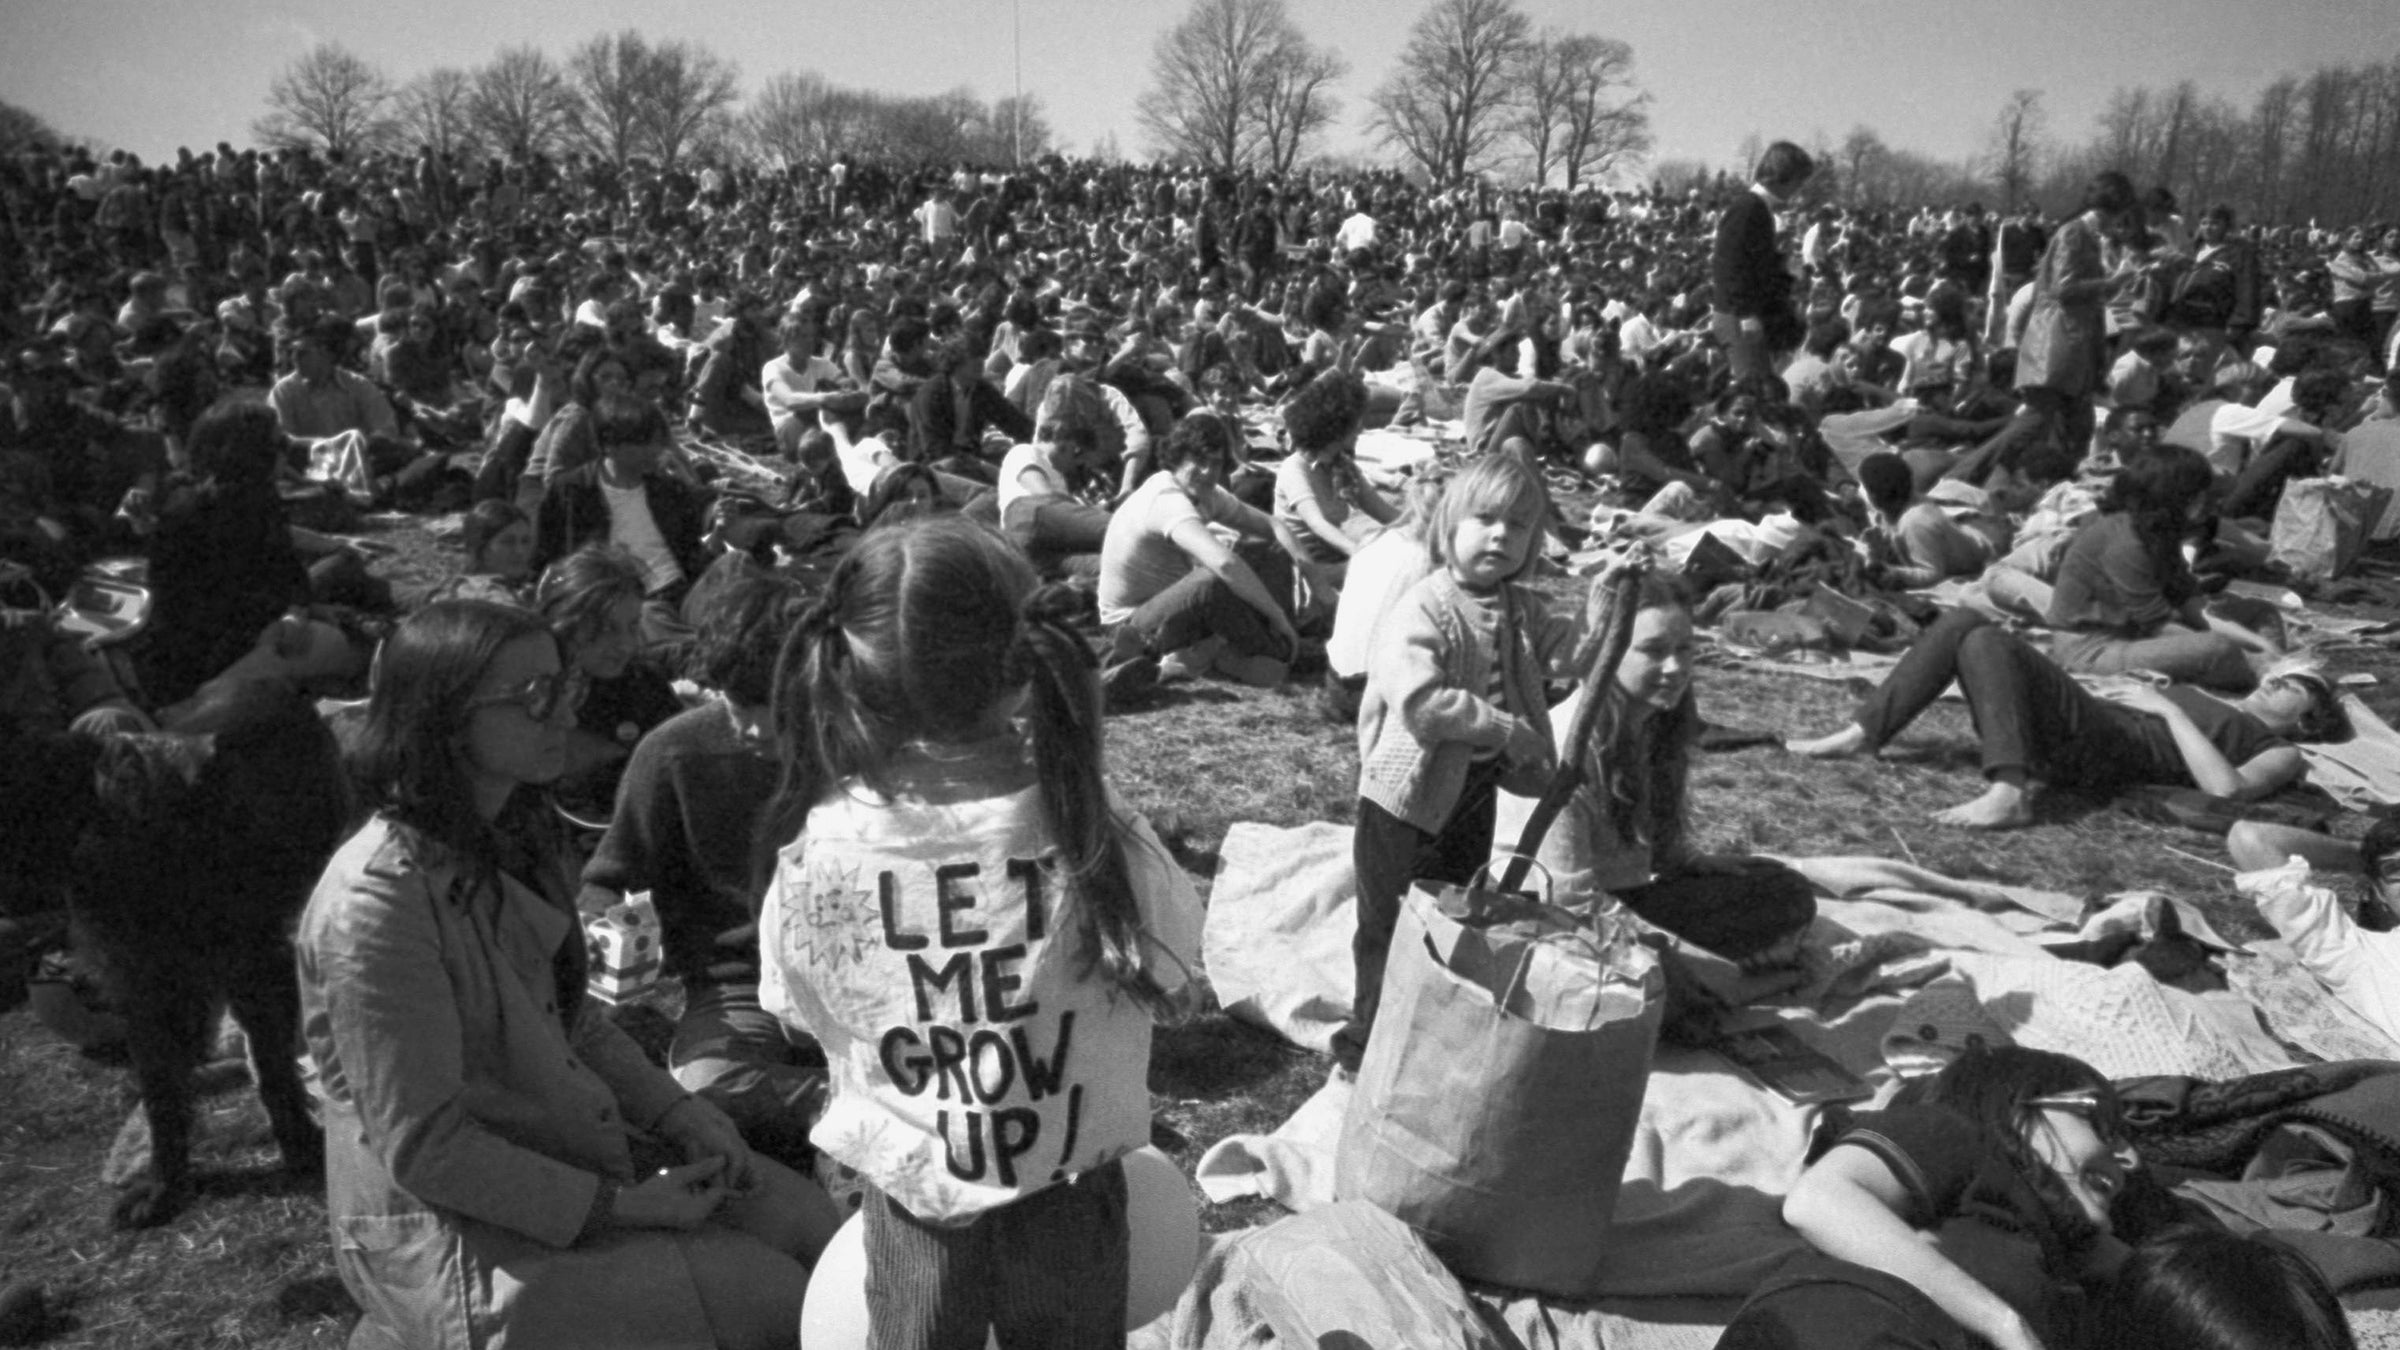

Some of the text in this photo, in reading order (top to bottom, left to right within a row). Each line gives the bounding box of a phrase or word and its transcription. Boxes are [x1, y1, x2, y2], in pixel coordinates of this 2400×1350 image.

[878, 858, 1055, 950] LET
[906, 943, 1039, 1024] ME
[880, 1010, 1075, 1105] GROW
[937, 1083, 1083, 1188] UP!
